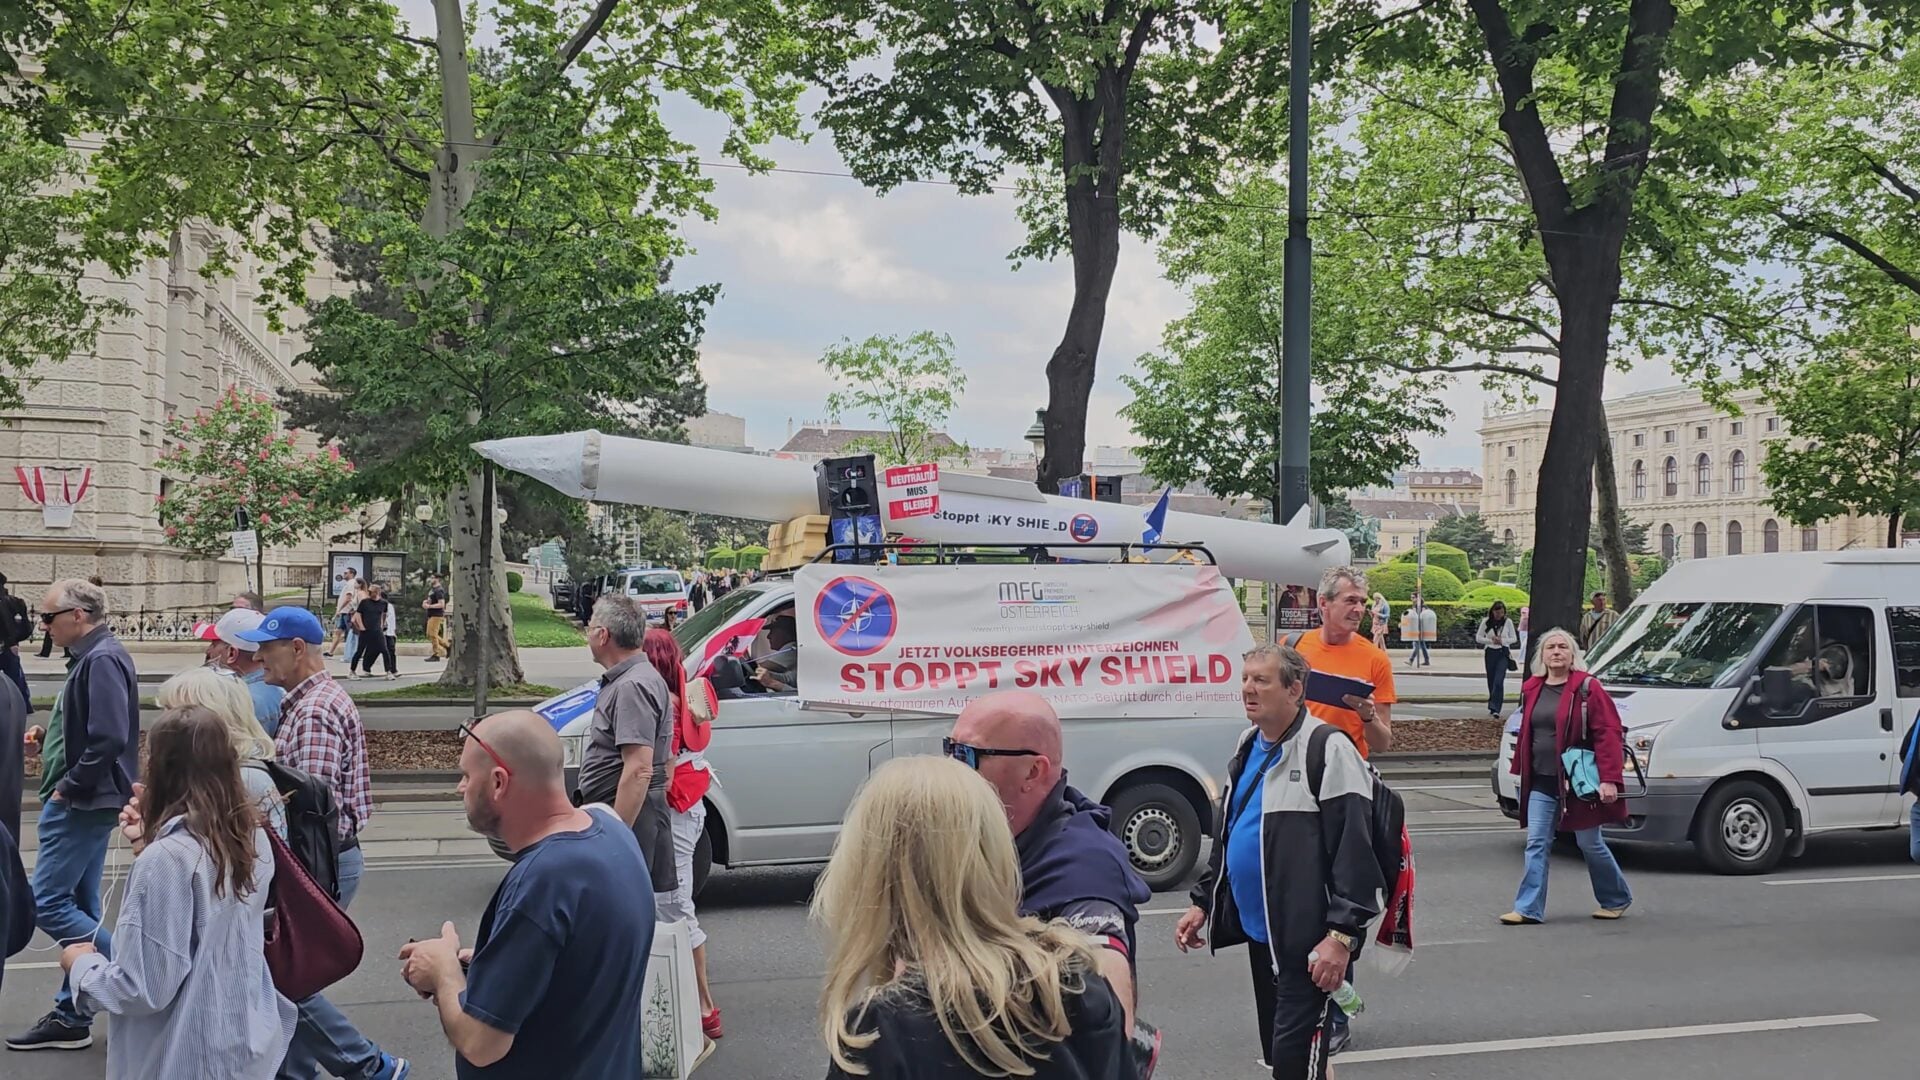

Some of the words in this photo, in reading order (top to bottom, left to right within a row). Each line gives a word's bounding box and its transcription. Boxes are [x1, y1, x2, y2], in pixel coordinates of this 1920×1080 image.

[906, 486, 928, 497] MUSS
[933, 510, 980, 525] Stoppt
[1016, 517, 1068, 532] SHIED
[999, 581, 1044, 601] MFG
[1281, 610, 1302, 618] TOSCA
[898, 646, 940, 659] JETZT
[943, 644, 1064, 658] VOLKSBEGEHREN
[1066, 641, 1179, 655] UNTERZEICHNEN
[840, 660, 1002, 692] STOPPT
[1014, 657, 1092, 688] SKY
[1100, 653, 1232, 686] SHIELD
[879, 698, 944, 709] atomaren
[1138, 690, 1172, 703] durch
[1174, 690, 1193, 702] die
